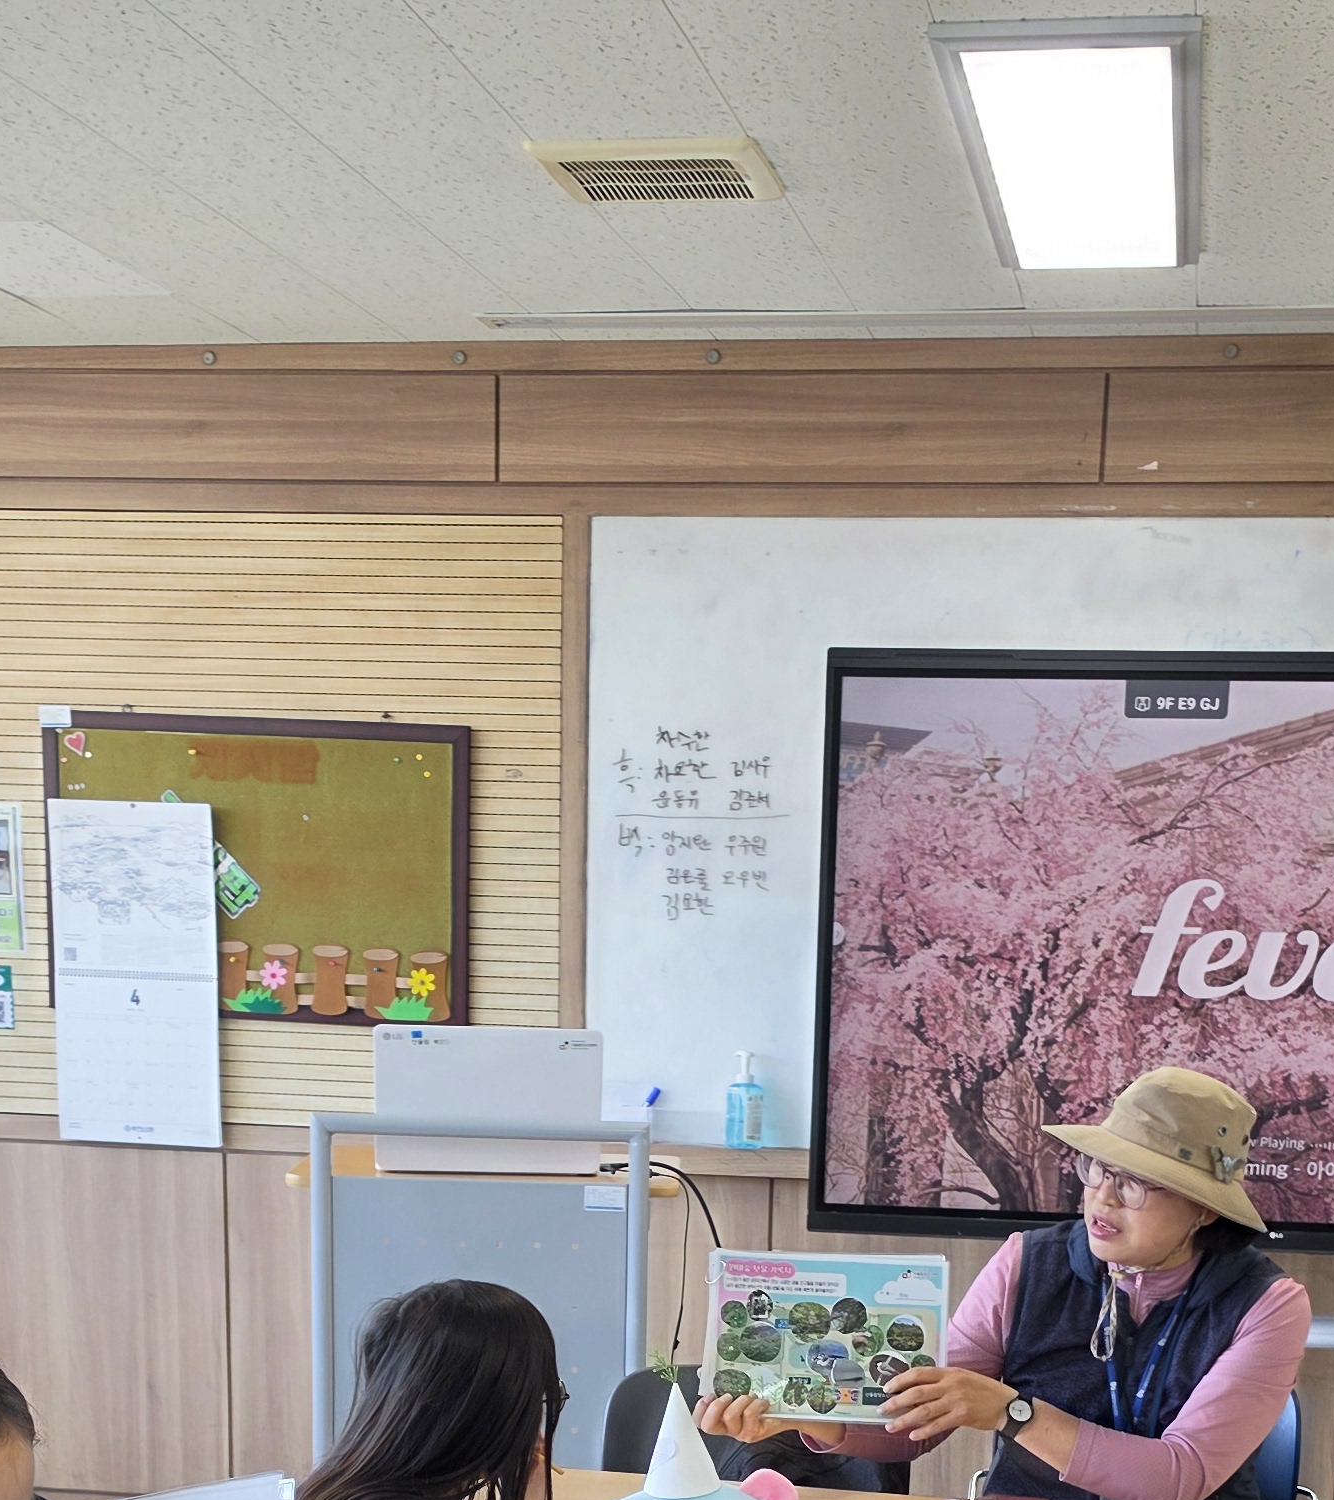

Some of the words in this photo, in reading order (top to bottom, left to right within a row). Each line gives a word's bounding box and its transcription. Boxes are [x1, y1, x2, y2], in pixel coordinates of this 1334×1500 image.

[1156, 697, 1175, 710] 9F
[1178, 697, 1196, 710] E9
[1200, 697, 1220, 710] GJ
[129, 988, 141, 1006] 4
[1260, 1136, 1305, 1151] Playing
[1244, 1160, 1288, 1179] ming
